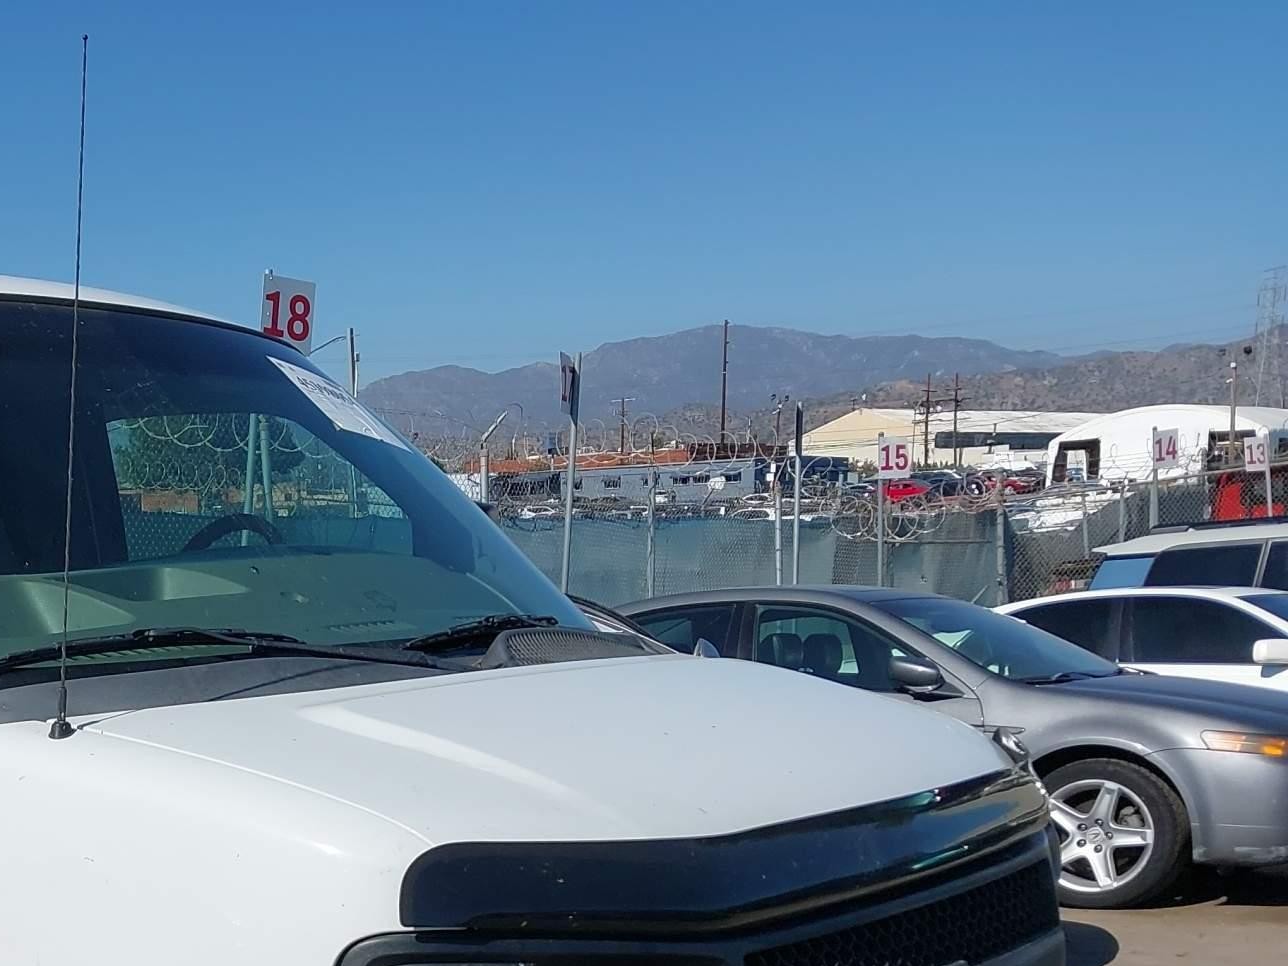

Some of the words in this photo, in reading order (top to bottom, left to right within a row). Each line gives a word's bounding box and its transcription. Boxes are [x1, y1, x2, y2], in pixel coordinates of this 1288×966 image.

[264, 291, 311, 342] 18
[880, 444, 909, 471] 15
[1155, 435, 1178, 462] 14
[1246, 442, 1266, 465] 13
